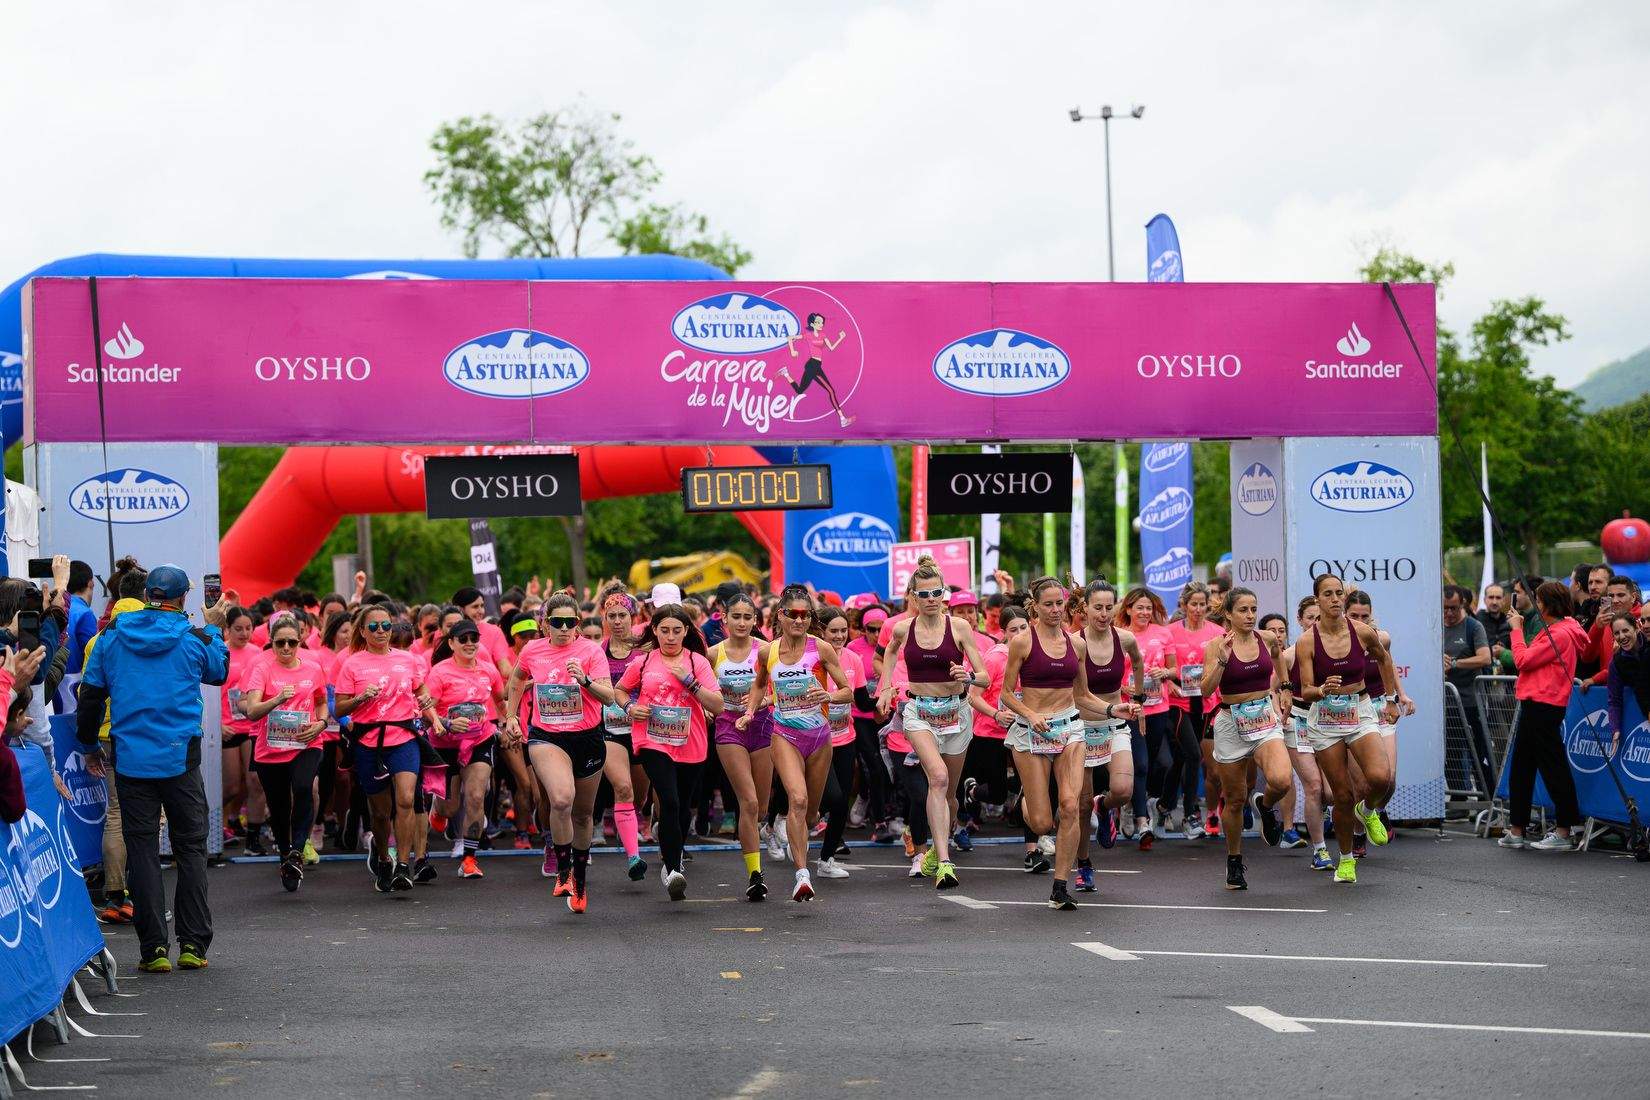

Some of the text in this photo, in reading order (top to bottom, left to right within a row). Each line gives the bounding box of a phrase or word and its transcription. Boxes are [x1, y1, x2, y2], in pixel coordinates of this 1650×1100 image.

[682, 315, 790, 339] ASTURIANA
[67, 363, 182, 383] Santander
[255, 356, 371, 381] OYSHO
[455, 355, 579, 380] ASTURIANA
[660, 350, 768, 383] Carrera
[944, 353, 1060, 379] ASTURIANA
[1137, 354, 1242, 378] OYSHO
[1305, 360, 1404, 379] Santander
[687, 379, 807, 433] de la Mujer
[450, 474, 559, 500] OYSHO
[950, 471, 1052, 496] OYSHO
[1240, 483, 1275, 503] ASTURIANA
[1318, 480, 1406, 500] ASTURIANA
[78, 489, 180, 510] ASTURIANA
[811, 532, 890, 555] ASTURIAN
[1239, 558, 1279, 583] OYSHO
[1309, 557, 1416, 582] OYSHO
